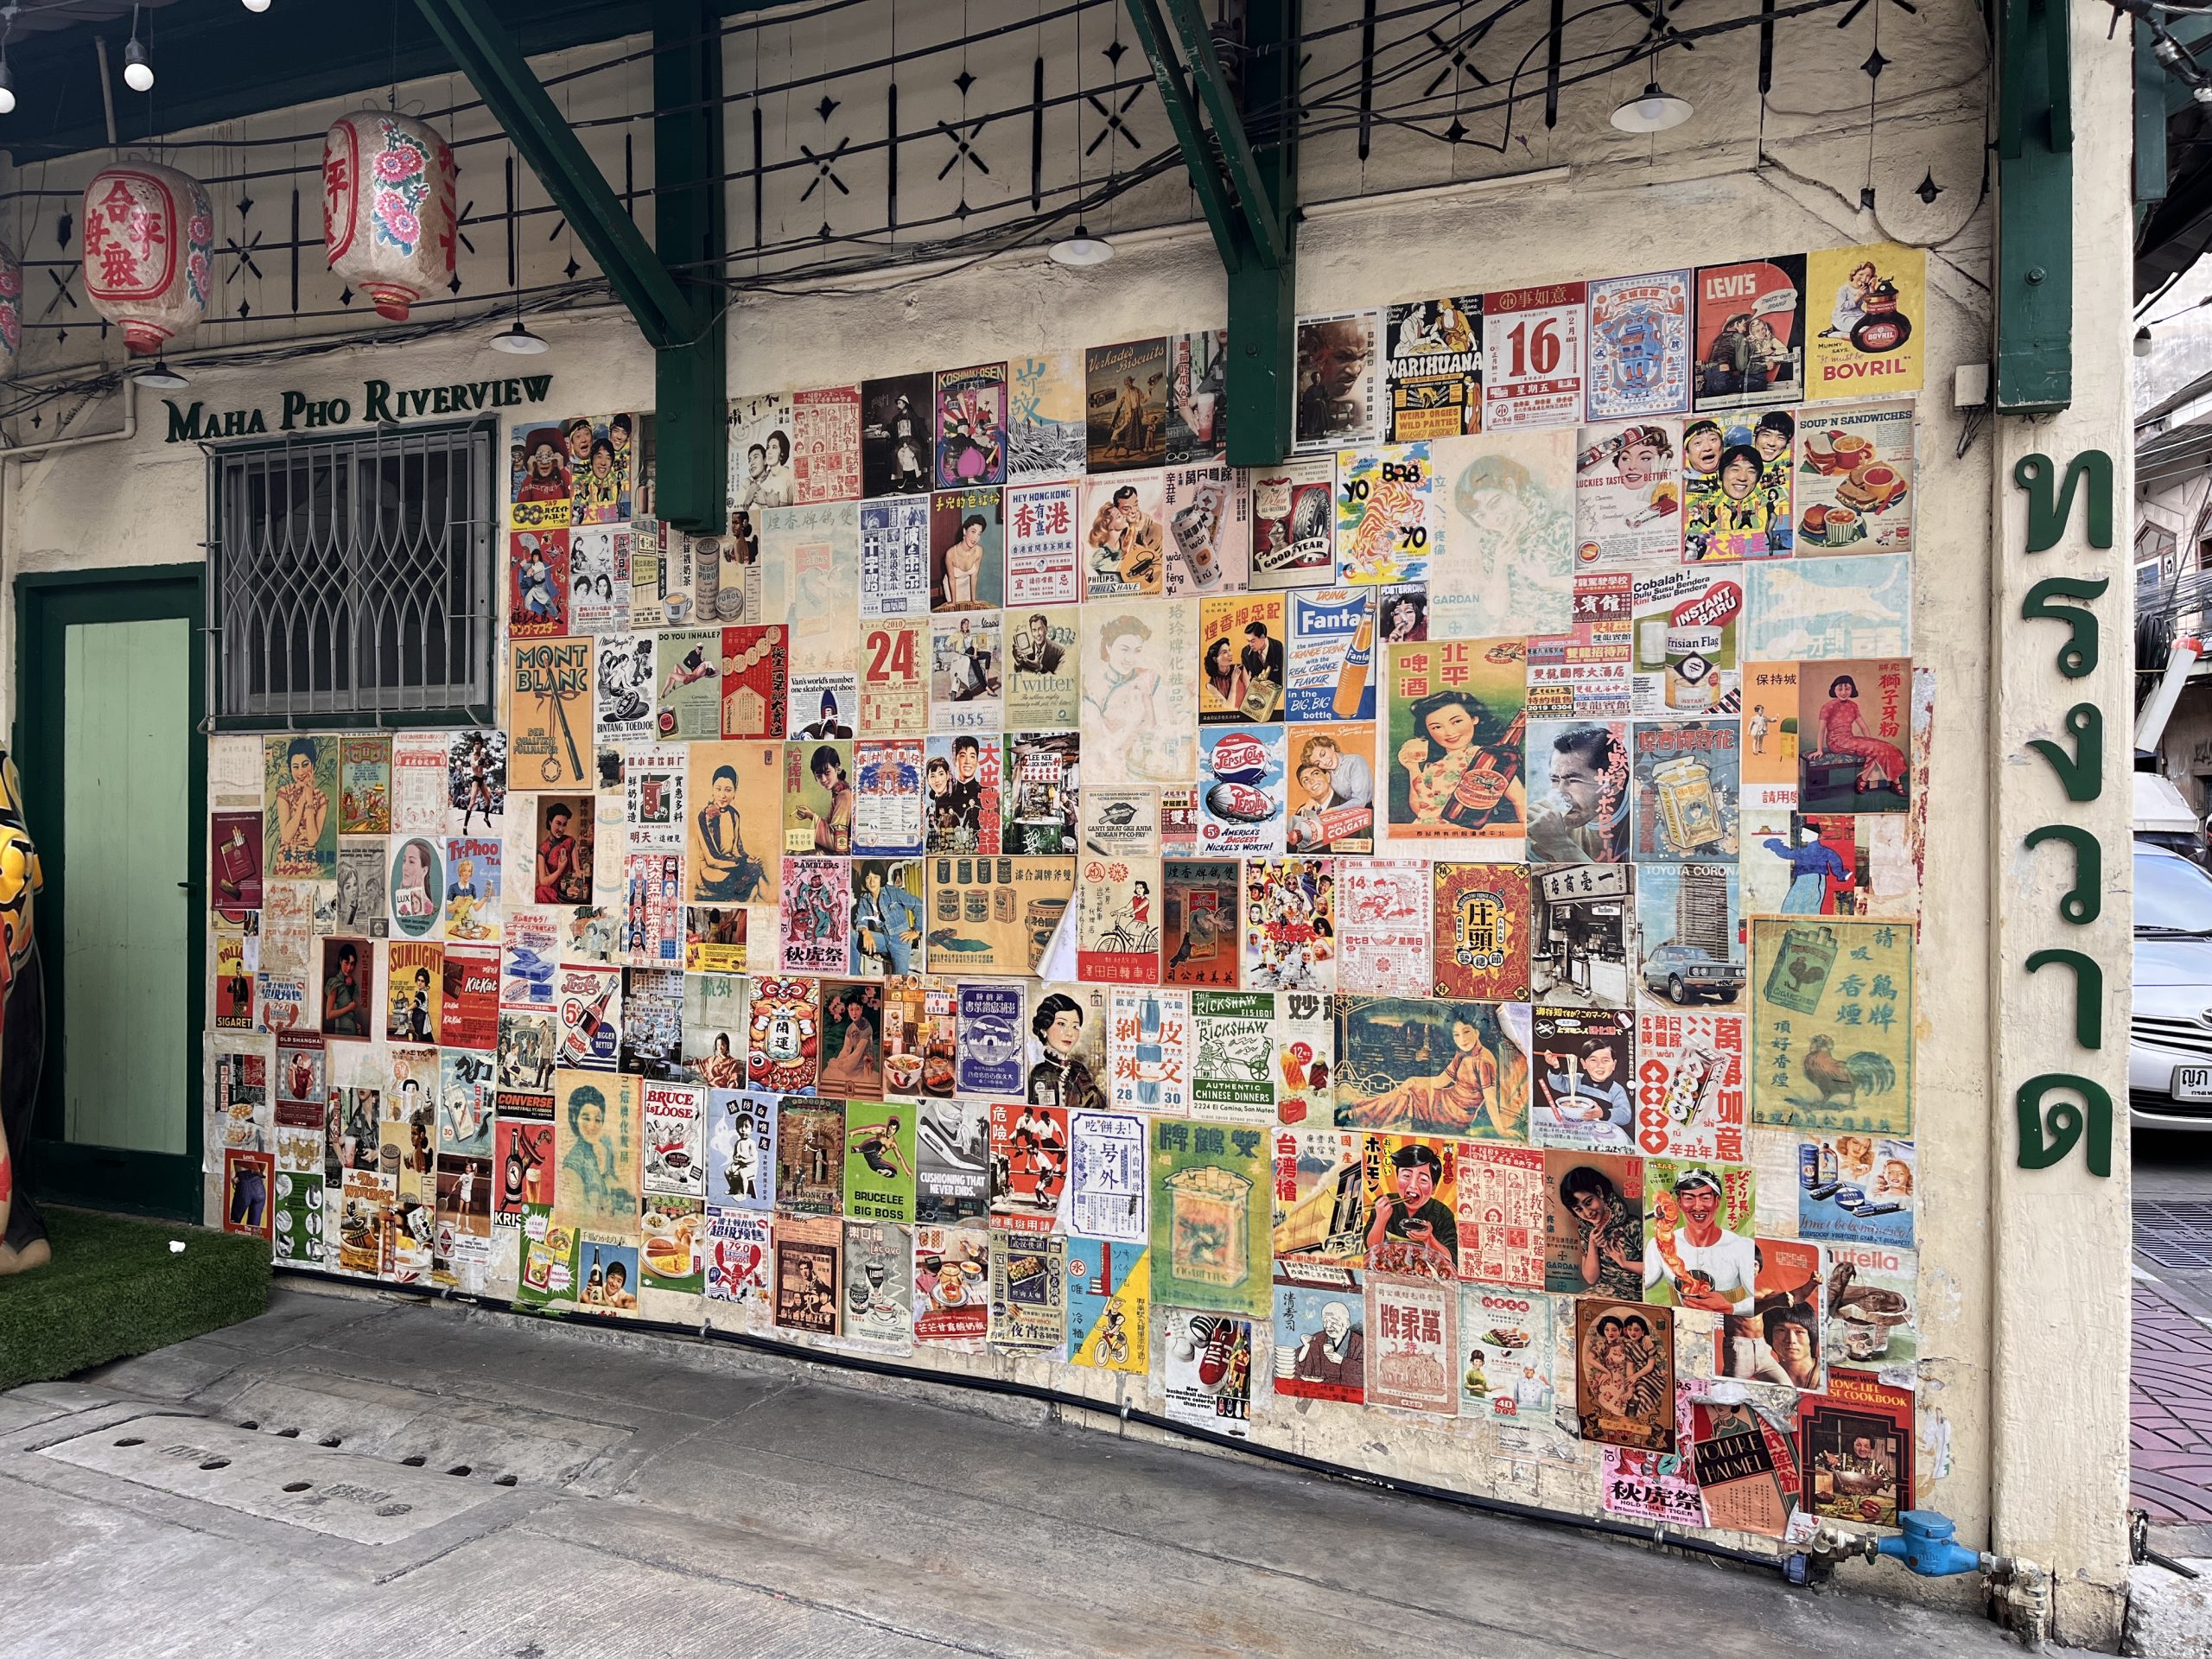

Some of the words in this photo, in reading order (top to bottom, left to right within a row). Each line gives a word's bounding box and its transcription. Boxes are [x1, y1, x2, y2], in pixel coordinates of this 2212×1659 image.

[1707, 273, 1756, 300] LEVI'S
[1507, 317, 1560, 377] 16
[1386, 352, 1483, 379] MARIHUANA
[1516, 384, 1549, 396] 星期五
[1399, 410, 1425, 420] WEIRD
[1430, 408, 1459, 418] ORGIES
[1800, 418, 1823, 429] SOUP
[1840, 410, 1912, 426] SANDWICHES
[1399, 421, 1421, 429] WILD
[1424, 418, 1459, 429] PARTIES
[1576, 479, 1603, 488] LUCKIES
[1606, 476, 1624, 485] TASTE
[1342, 480, 1369, 502] YO
[1013, 494, 1027, 503] HEY
[1401, 526, 1426, 548] YO
[1634, 572, 1683, 592] Cobalah
[1634, 589, 1651, 600] Dulu
[1654, 585, 1674, 594] Susu
[1676, 577, 1710, 589] Bendera
[1316, 591, 1346, 601] DRINK
[1651, 592, 1672, 601] Susu
[1674, 584, 1707, 597] Bendera
[1675, 587, 1731, 626] INSTANT
[1699, 597, 1737, 626] BARU
[1303, 609, 1361, 633] Fanta
[659, 632, 669, 641] DO
[1308, 638, 1339, 648] sensational
[1668, 637, 1700, 648] Frisian
[1701, 636, 1719, 646] Flag
[516, 645, 588, 669] MONT
[867, 629, 914, 681] 24
[1313, 697, 1331, 709] BIG
[597, 722, 623, 734] BINTANG
[626, 721, 654, 732] TOEDJOE
[1328, 817, 1370, 839] COLGATE
[1243, 842, 1273, 851] WORTH!
[1645, 866, 1691, 876] TOYOTA
[397, 894, 410, 903] LUX
[390, 945, 442, 974] SUNLIGHT
[464, 976, 498, 994] KitKat
[217, 1018, 252, 1028] SIGARET
[646, 1090, 694, 1106] BRUCE
[1116, 1088, 1133, 1100] 28
[1164, 1092, 1181, 1104] 30
[1196, 1090, 1230, 1100] CHINESE
[1235, 1093, 1269, 1102] DINNERS
[992, 1105, 1008, 1141] 危險
[920, 1173, 965, 1185] CUSHIONING
[966, 1176, 985, 1187] THAT
[930, 1184, 953, 1194] NEVER
[955, 1186, 976, 1197] ENDS.
[855, 1206, 871, 1216] BIG
[875, 1208, 904, 1219] BOSS
[1546, 1262, 1580, 1272] GARDAN
[1844, 1391, 1907, 1407] COOKBOOK
[1695, 1433, 1763, 1466] POUDRE
